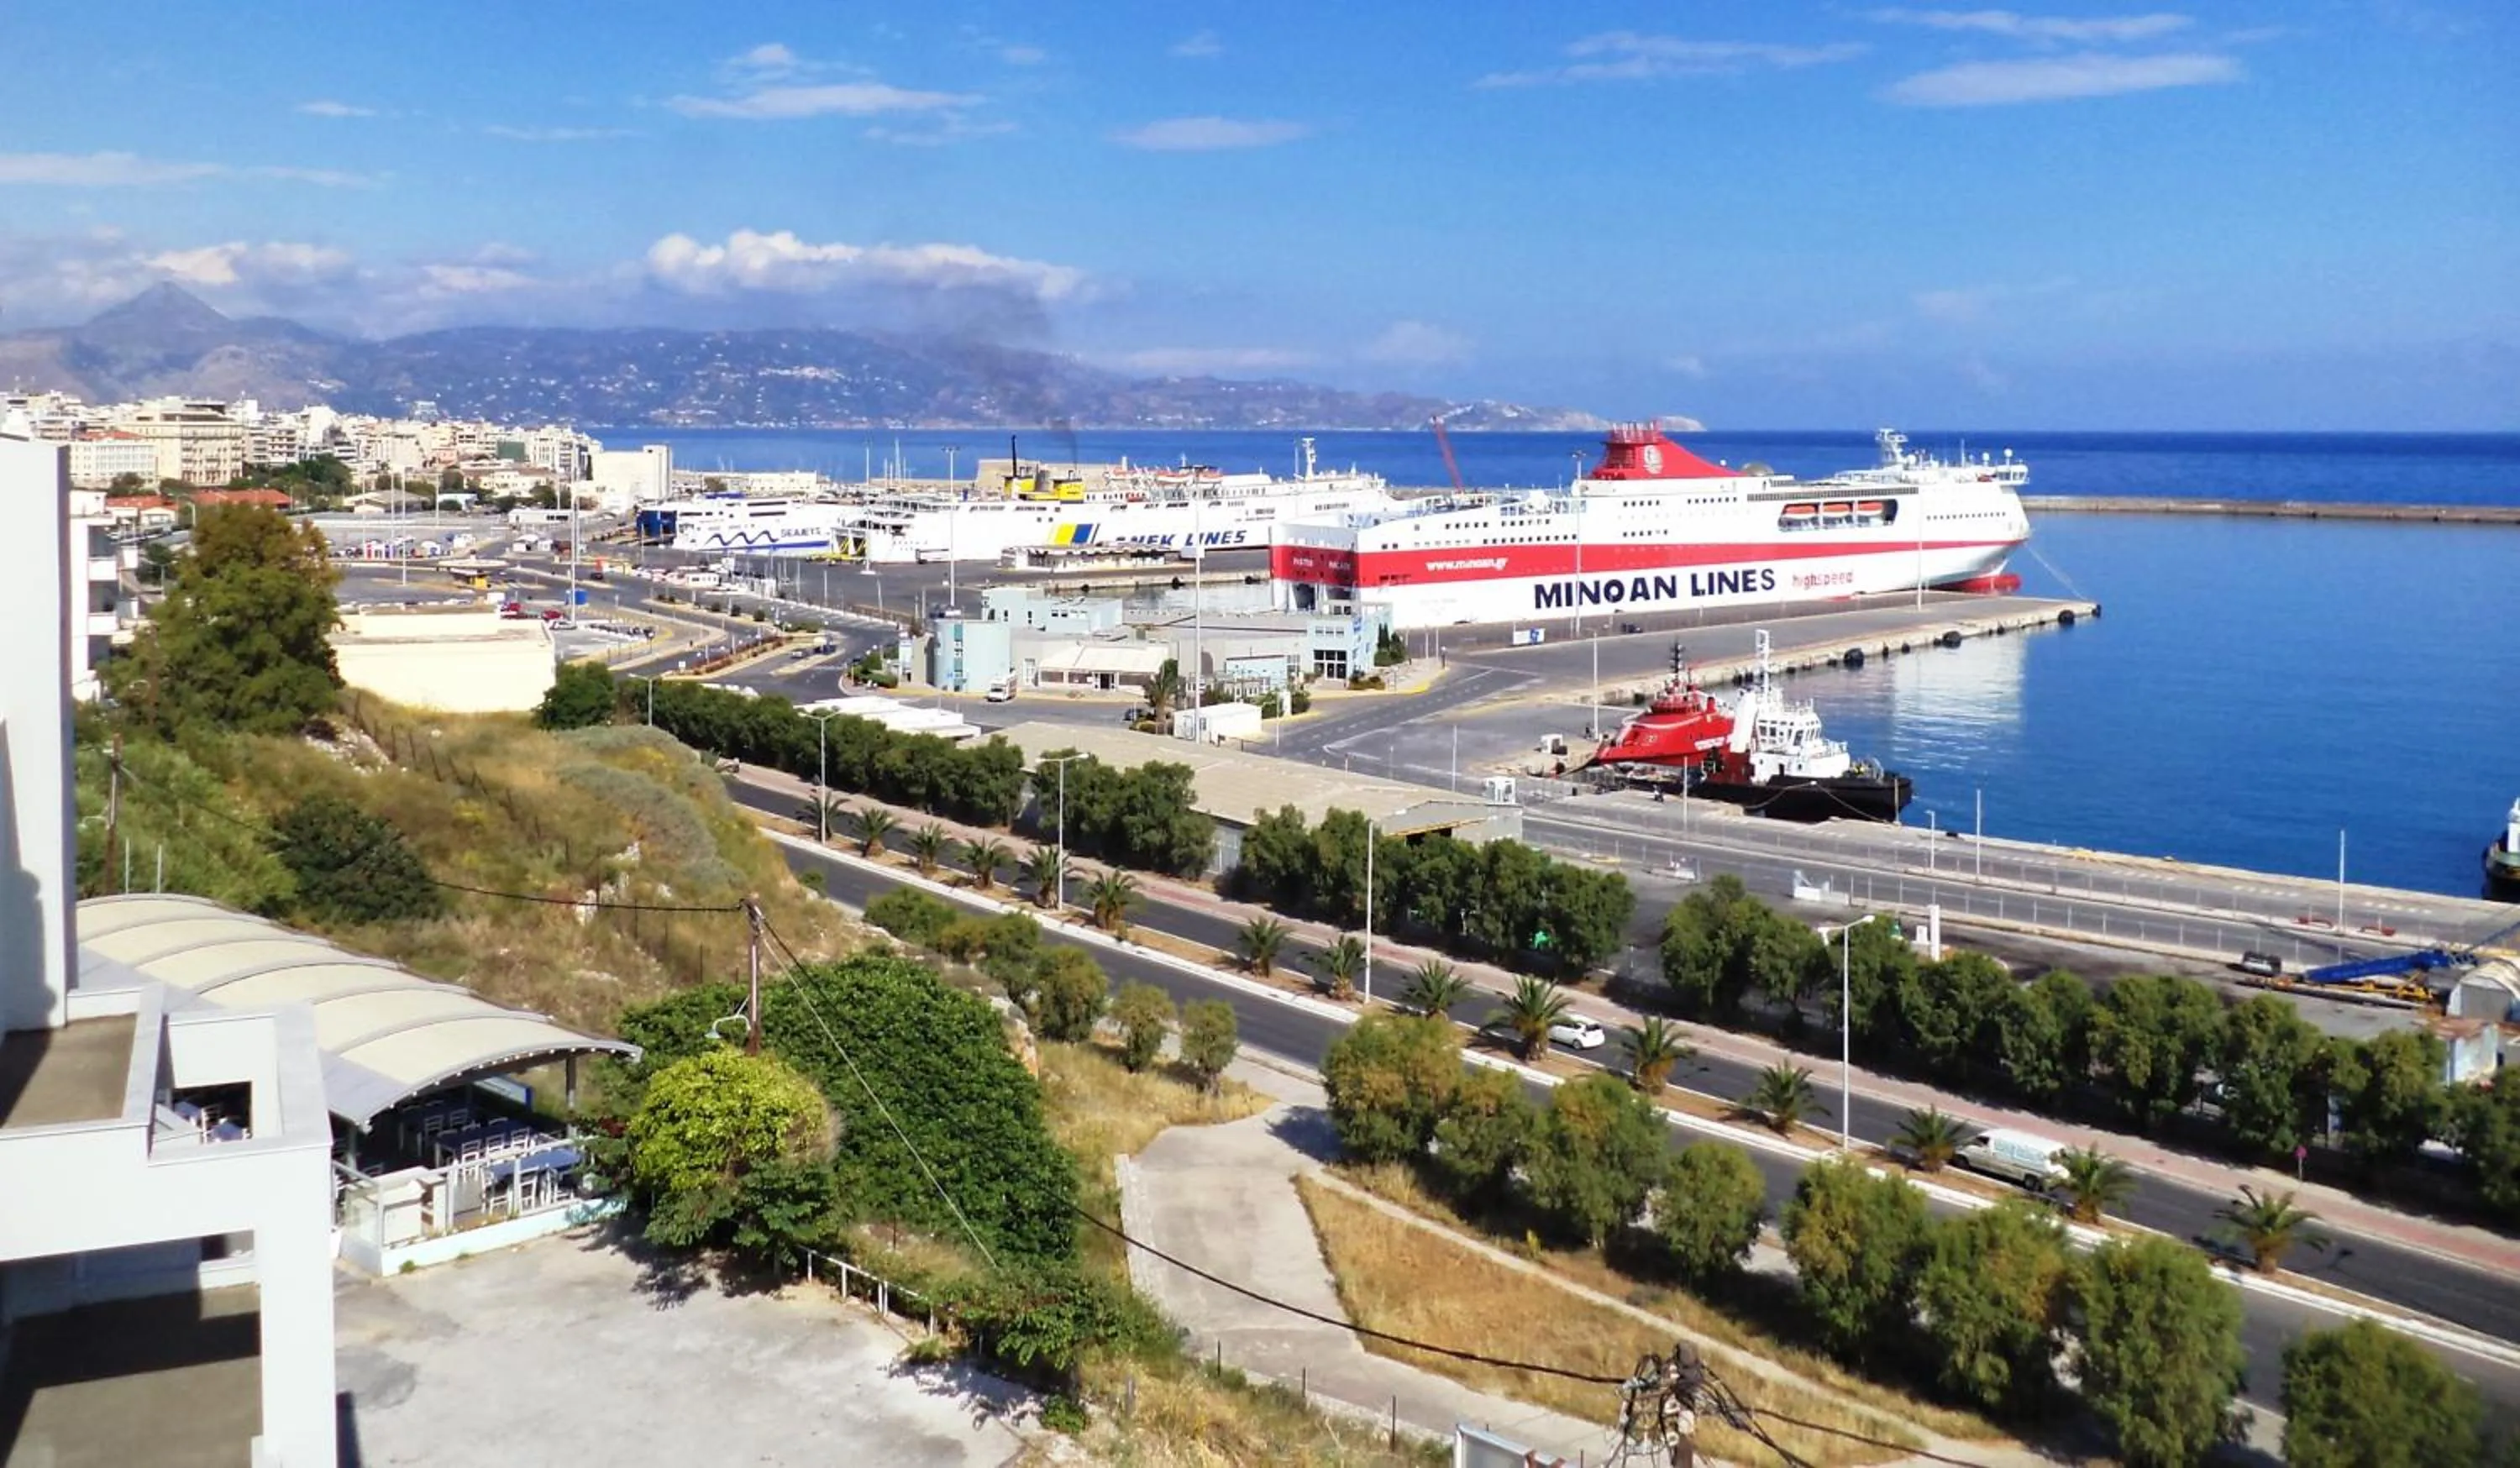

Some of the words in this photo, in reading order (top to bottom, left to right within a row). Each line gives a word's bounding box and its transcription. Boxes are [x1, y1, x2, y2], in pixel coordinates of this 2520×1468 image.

[1184, 529, 1247, 547] LINES
[1534, 574, 1677, 609] MINOAN
[1690, 568, 1776, 597] LINES
